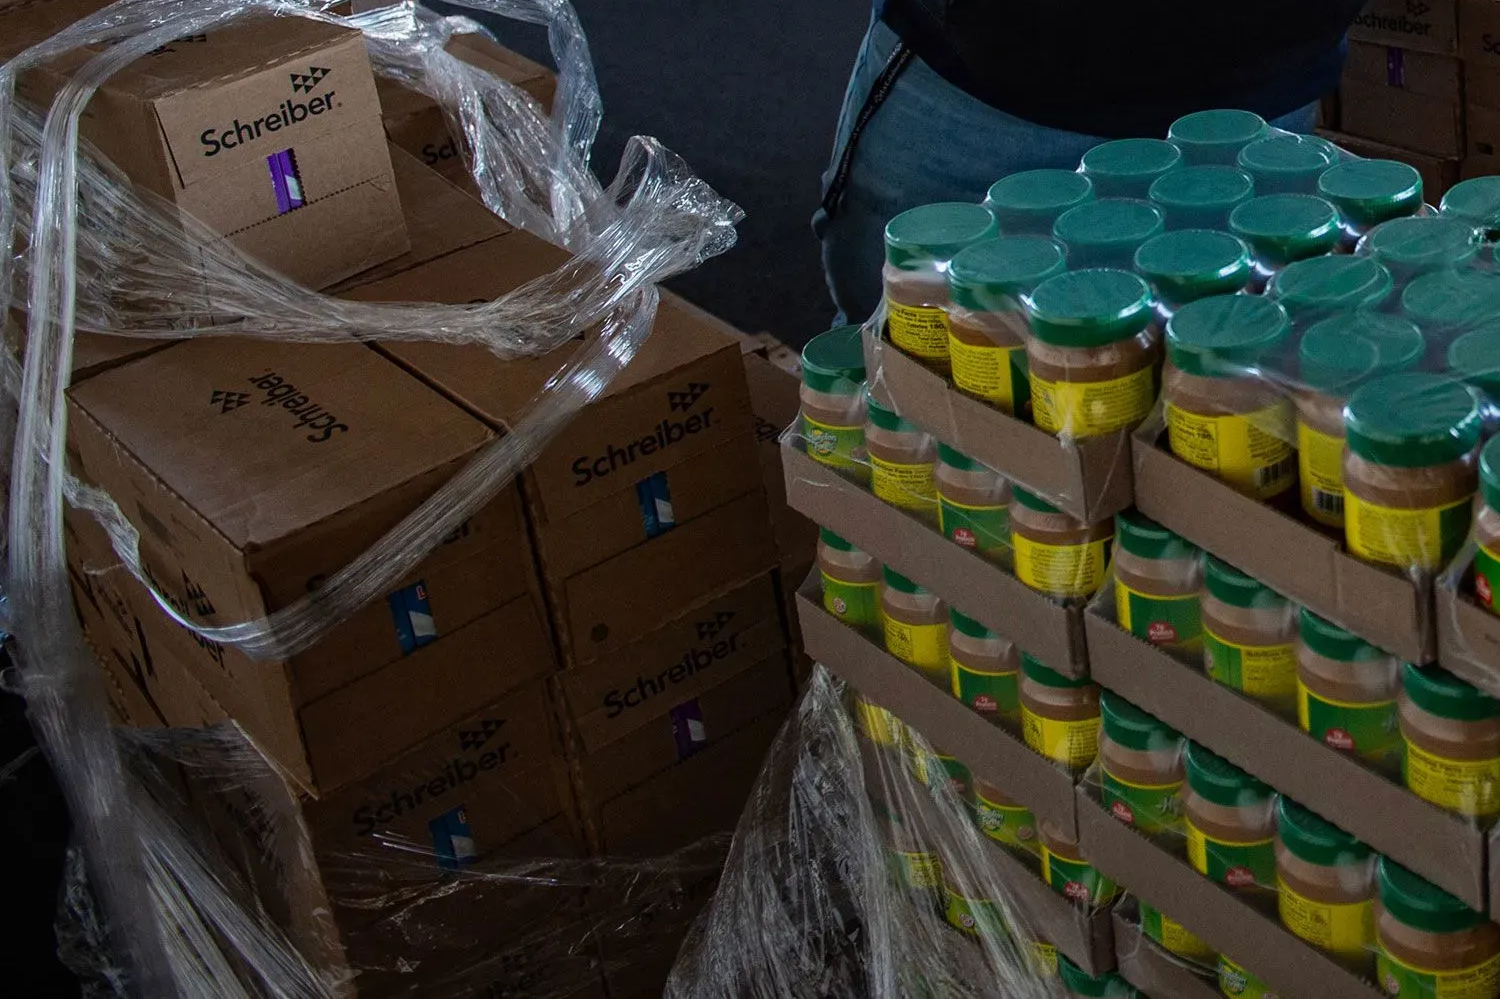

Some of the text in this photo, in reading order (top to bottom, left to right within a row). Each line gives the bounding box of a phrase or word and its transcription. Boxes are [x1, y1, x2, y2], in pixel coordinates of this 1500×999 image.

[200, 89, 337, 157] Schreiber
[248, 371, 349, 443] Schreiber
[571, 406, 714, 487] Schreiber
[602, 633, 739, 719] Schreiber
[352, 741, 511, 836] Schreiber
